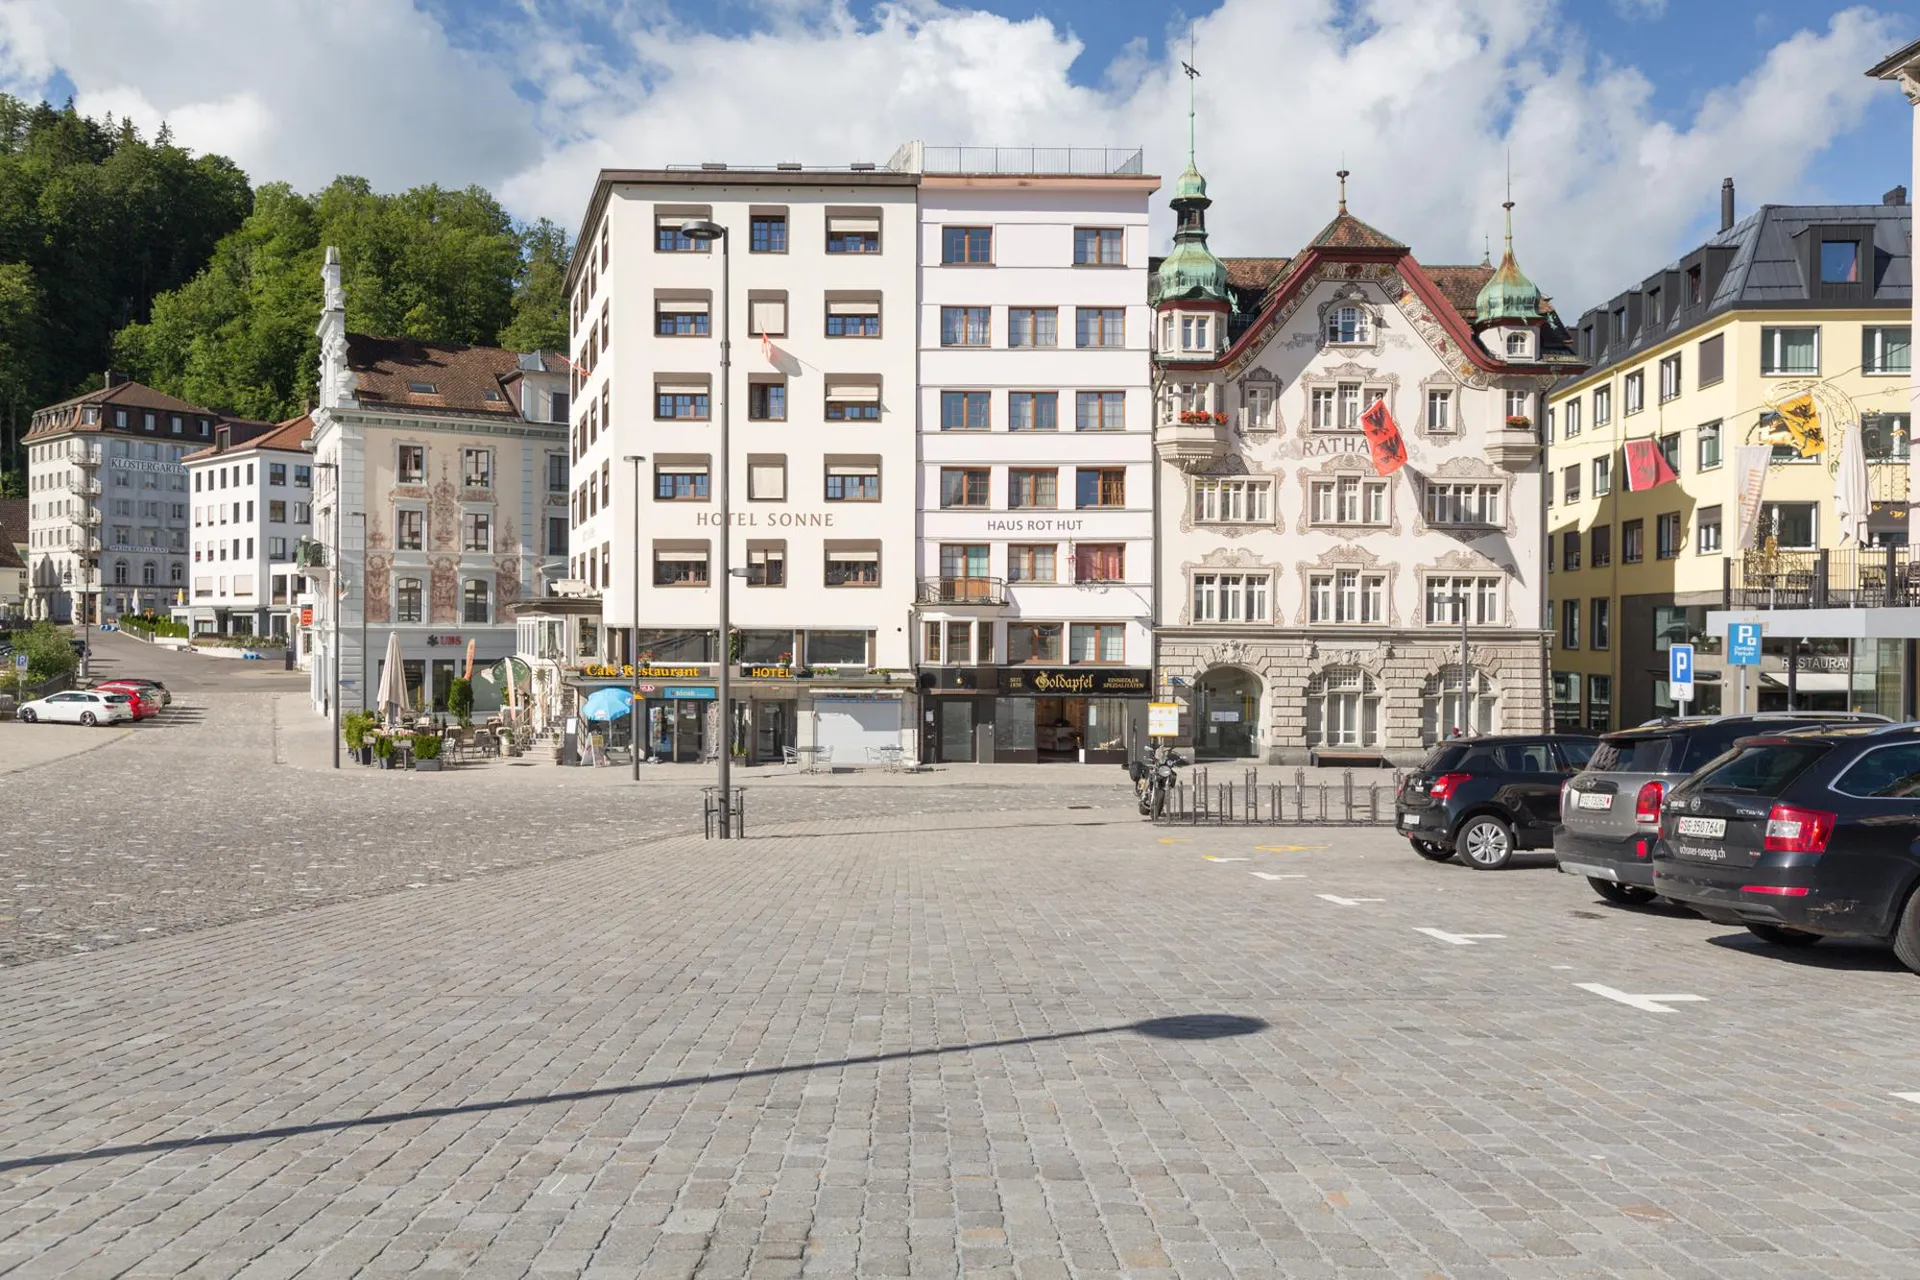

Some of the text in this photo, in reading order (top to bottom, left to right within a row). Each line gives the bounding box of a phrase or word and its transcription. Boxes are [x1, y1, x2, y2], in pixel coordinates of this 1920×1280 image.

[1302, 437, 1370, 456] RATHA
[111, 458, 189, 474] KLOSTERGARTEN
[696, 512, 834, 527] HOTEL SONNE
[987, 520, 1083, 531] HAUS ROT HUT
[440, 636, 462, 646] UBS
[1739, 625, 1752, 644] P
[752, 667, 793, 679] HOTEL
[1676, 652, 1688, 679] P
[1035, 670, 1094, 692] Goldapfel
